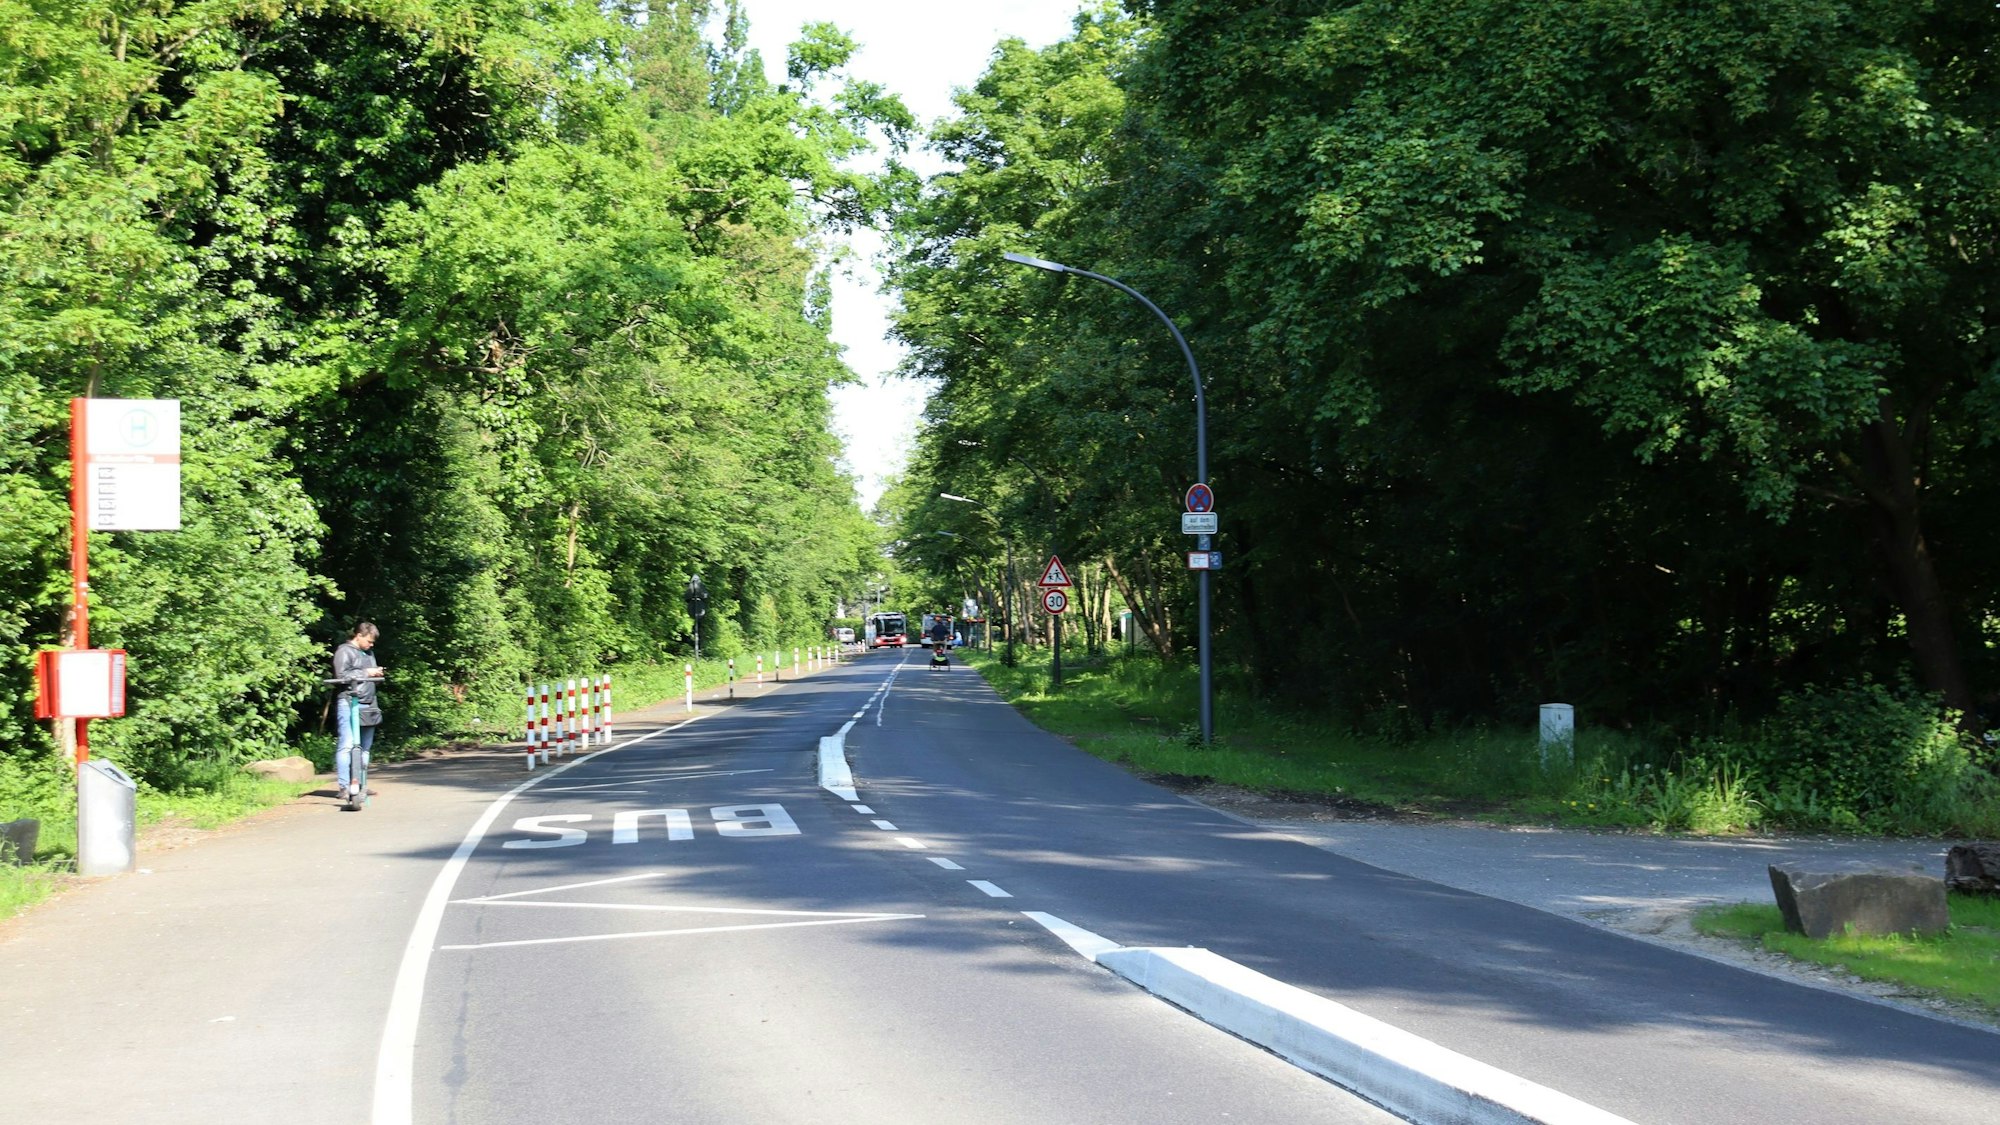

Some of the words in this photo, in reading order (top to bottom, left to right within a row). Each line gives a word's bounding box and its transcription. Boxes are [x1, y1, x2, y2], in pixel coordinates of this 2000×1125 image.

[130, 415, 148, 440] H
[1048, 595, 1063, 607] 30
[502, 803, 802, 849] BUS
